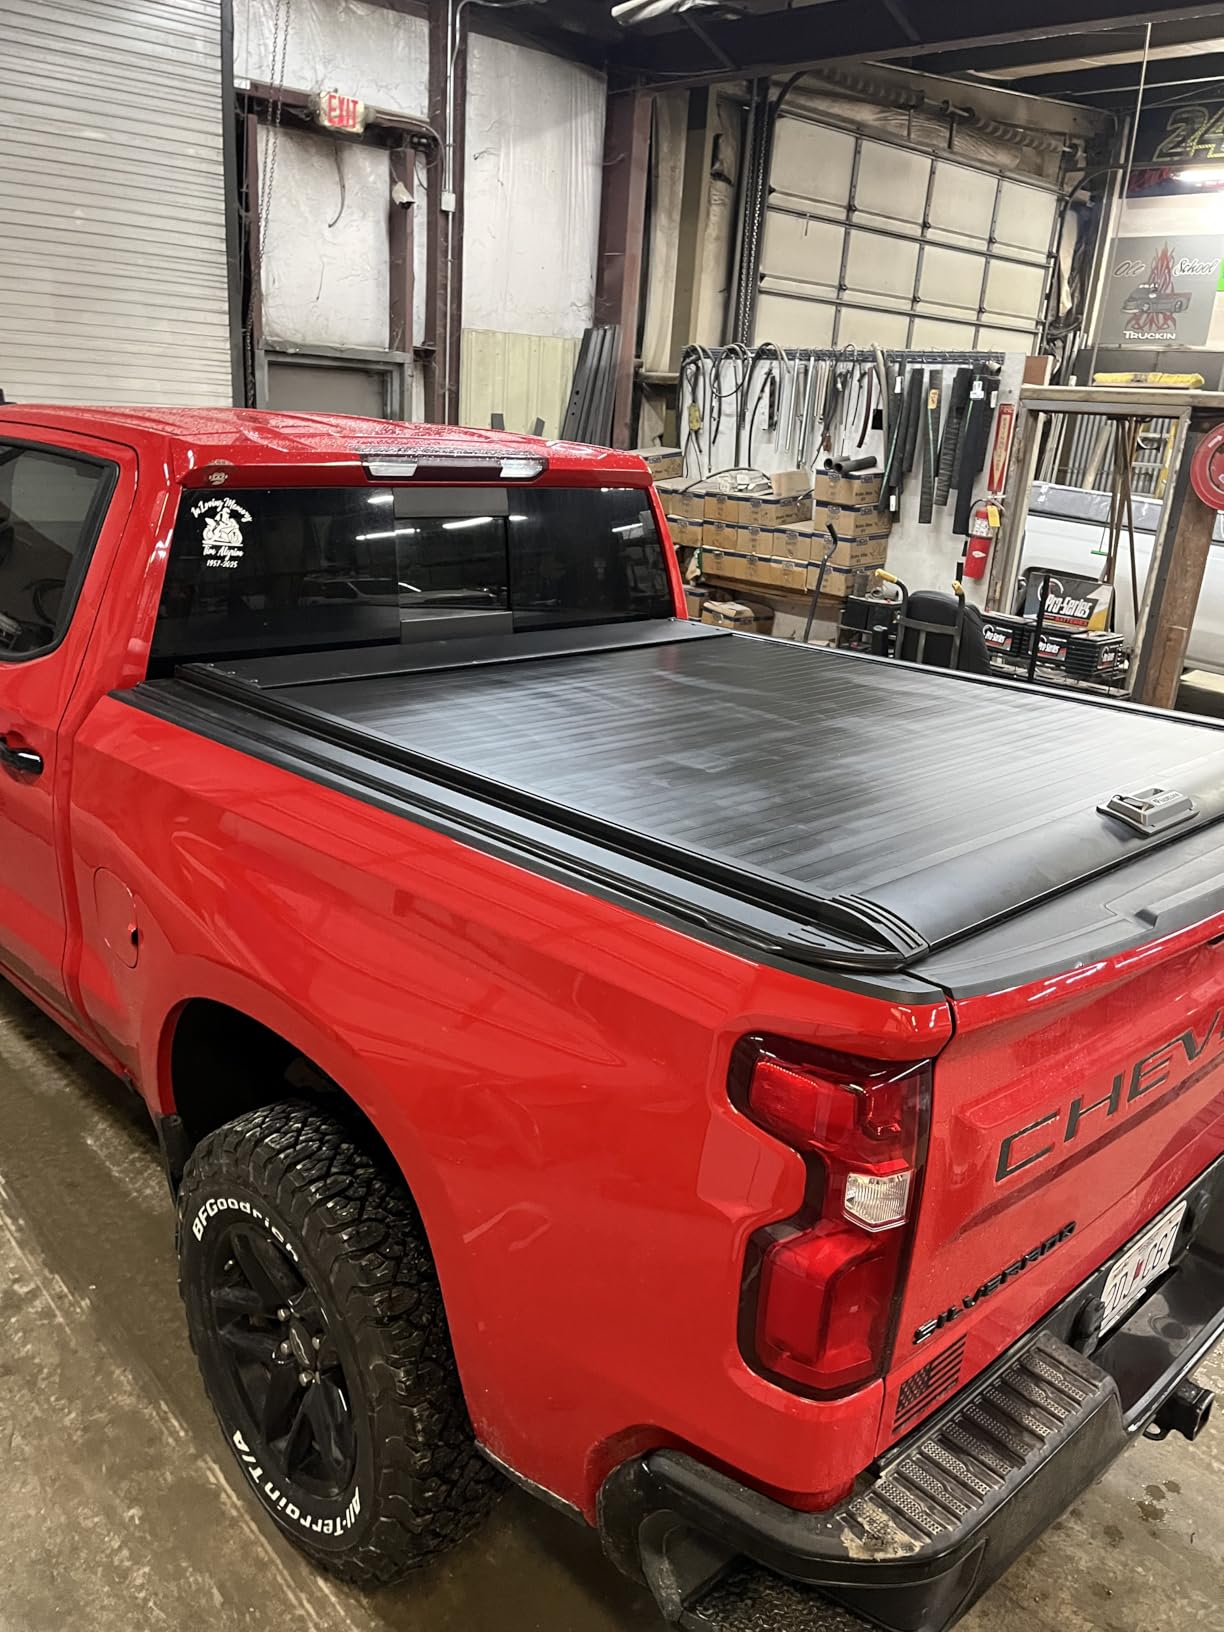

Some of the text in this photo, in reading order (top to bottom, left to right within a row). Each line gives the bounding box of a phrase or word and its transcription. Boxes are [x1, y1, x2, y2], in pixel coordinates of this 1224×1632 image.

[327, 94, 358, 129] EXIT
[1173, 257, 1220, 277] School
[198, 498, 224, 513] Loving
[224, 497, 253, 523] Memory
[202, 544, 217, 556] Tim
[1045, 594, 1093, 619] Pro-Series
[995, 1007, 1224, 1184] CHEV
[192, 1198, 299, 1263] BFGoodrich
[912, 1220, 1077, 1345] SILVERADO
